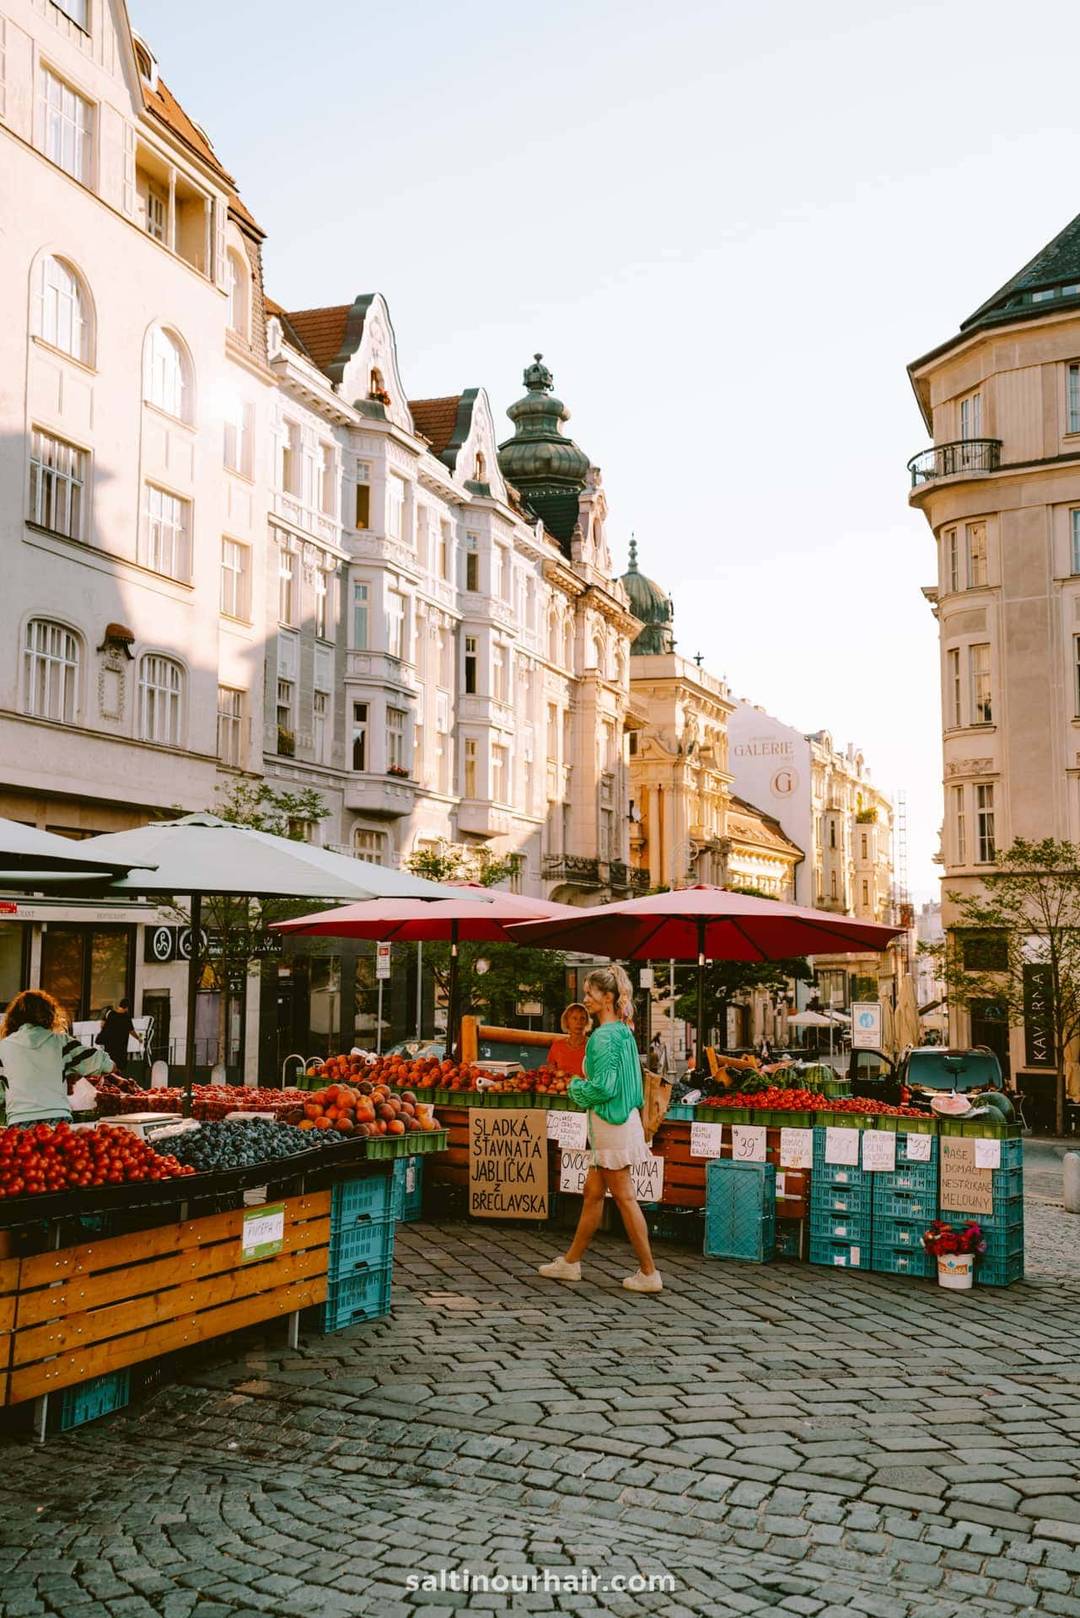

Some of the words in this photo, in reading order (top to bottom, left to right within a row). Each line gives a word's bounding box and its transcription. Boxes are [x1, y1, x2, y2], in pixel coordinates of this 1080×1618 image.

[734, 742, 794, 757] GALERIE
[775, 772, 792, 793] G
[473, 1115, 533, 1139] SLADKÁ,
[473, 1136, 542, 1158] ŠŤAVNATÁ
[472, 1158, 536, 1183] JABLÍČKA
[562, 1152, 590, 1170] OVOC
